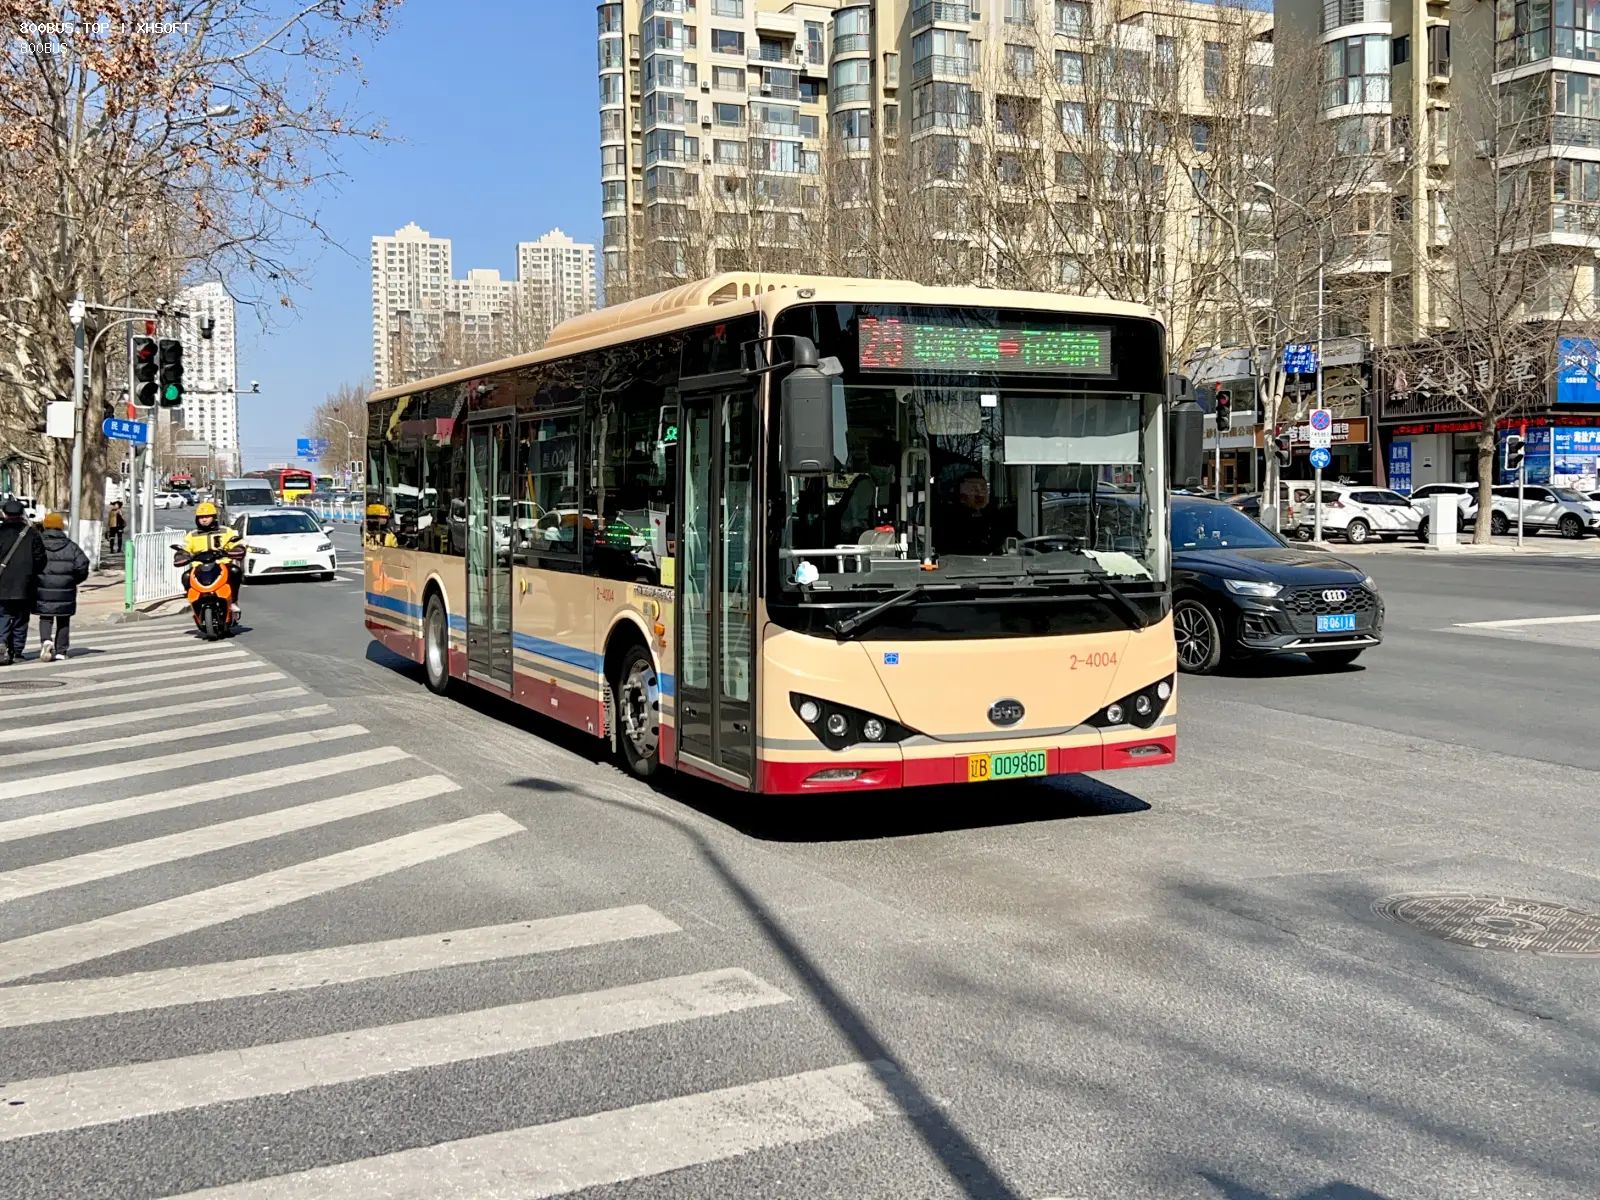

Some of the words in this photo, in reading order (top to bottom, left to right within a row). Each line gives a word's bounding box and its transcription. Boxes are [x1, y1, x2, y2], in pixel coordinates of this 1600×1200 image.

[111, 421, 140, 434] 民政街
[1069, 652, 1118, 670] 2-4004
[992, 705, 1022, 720] BYD
